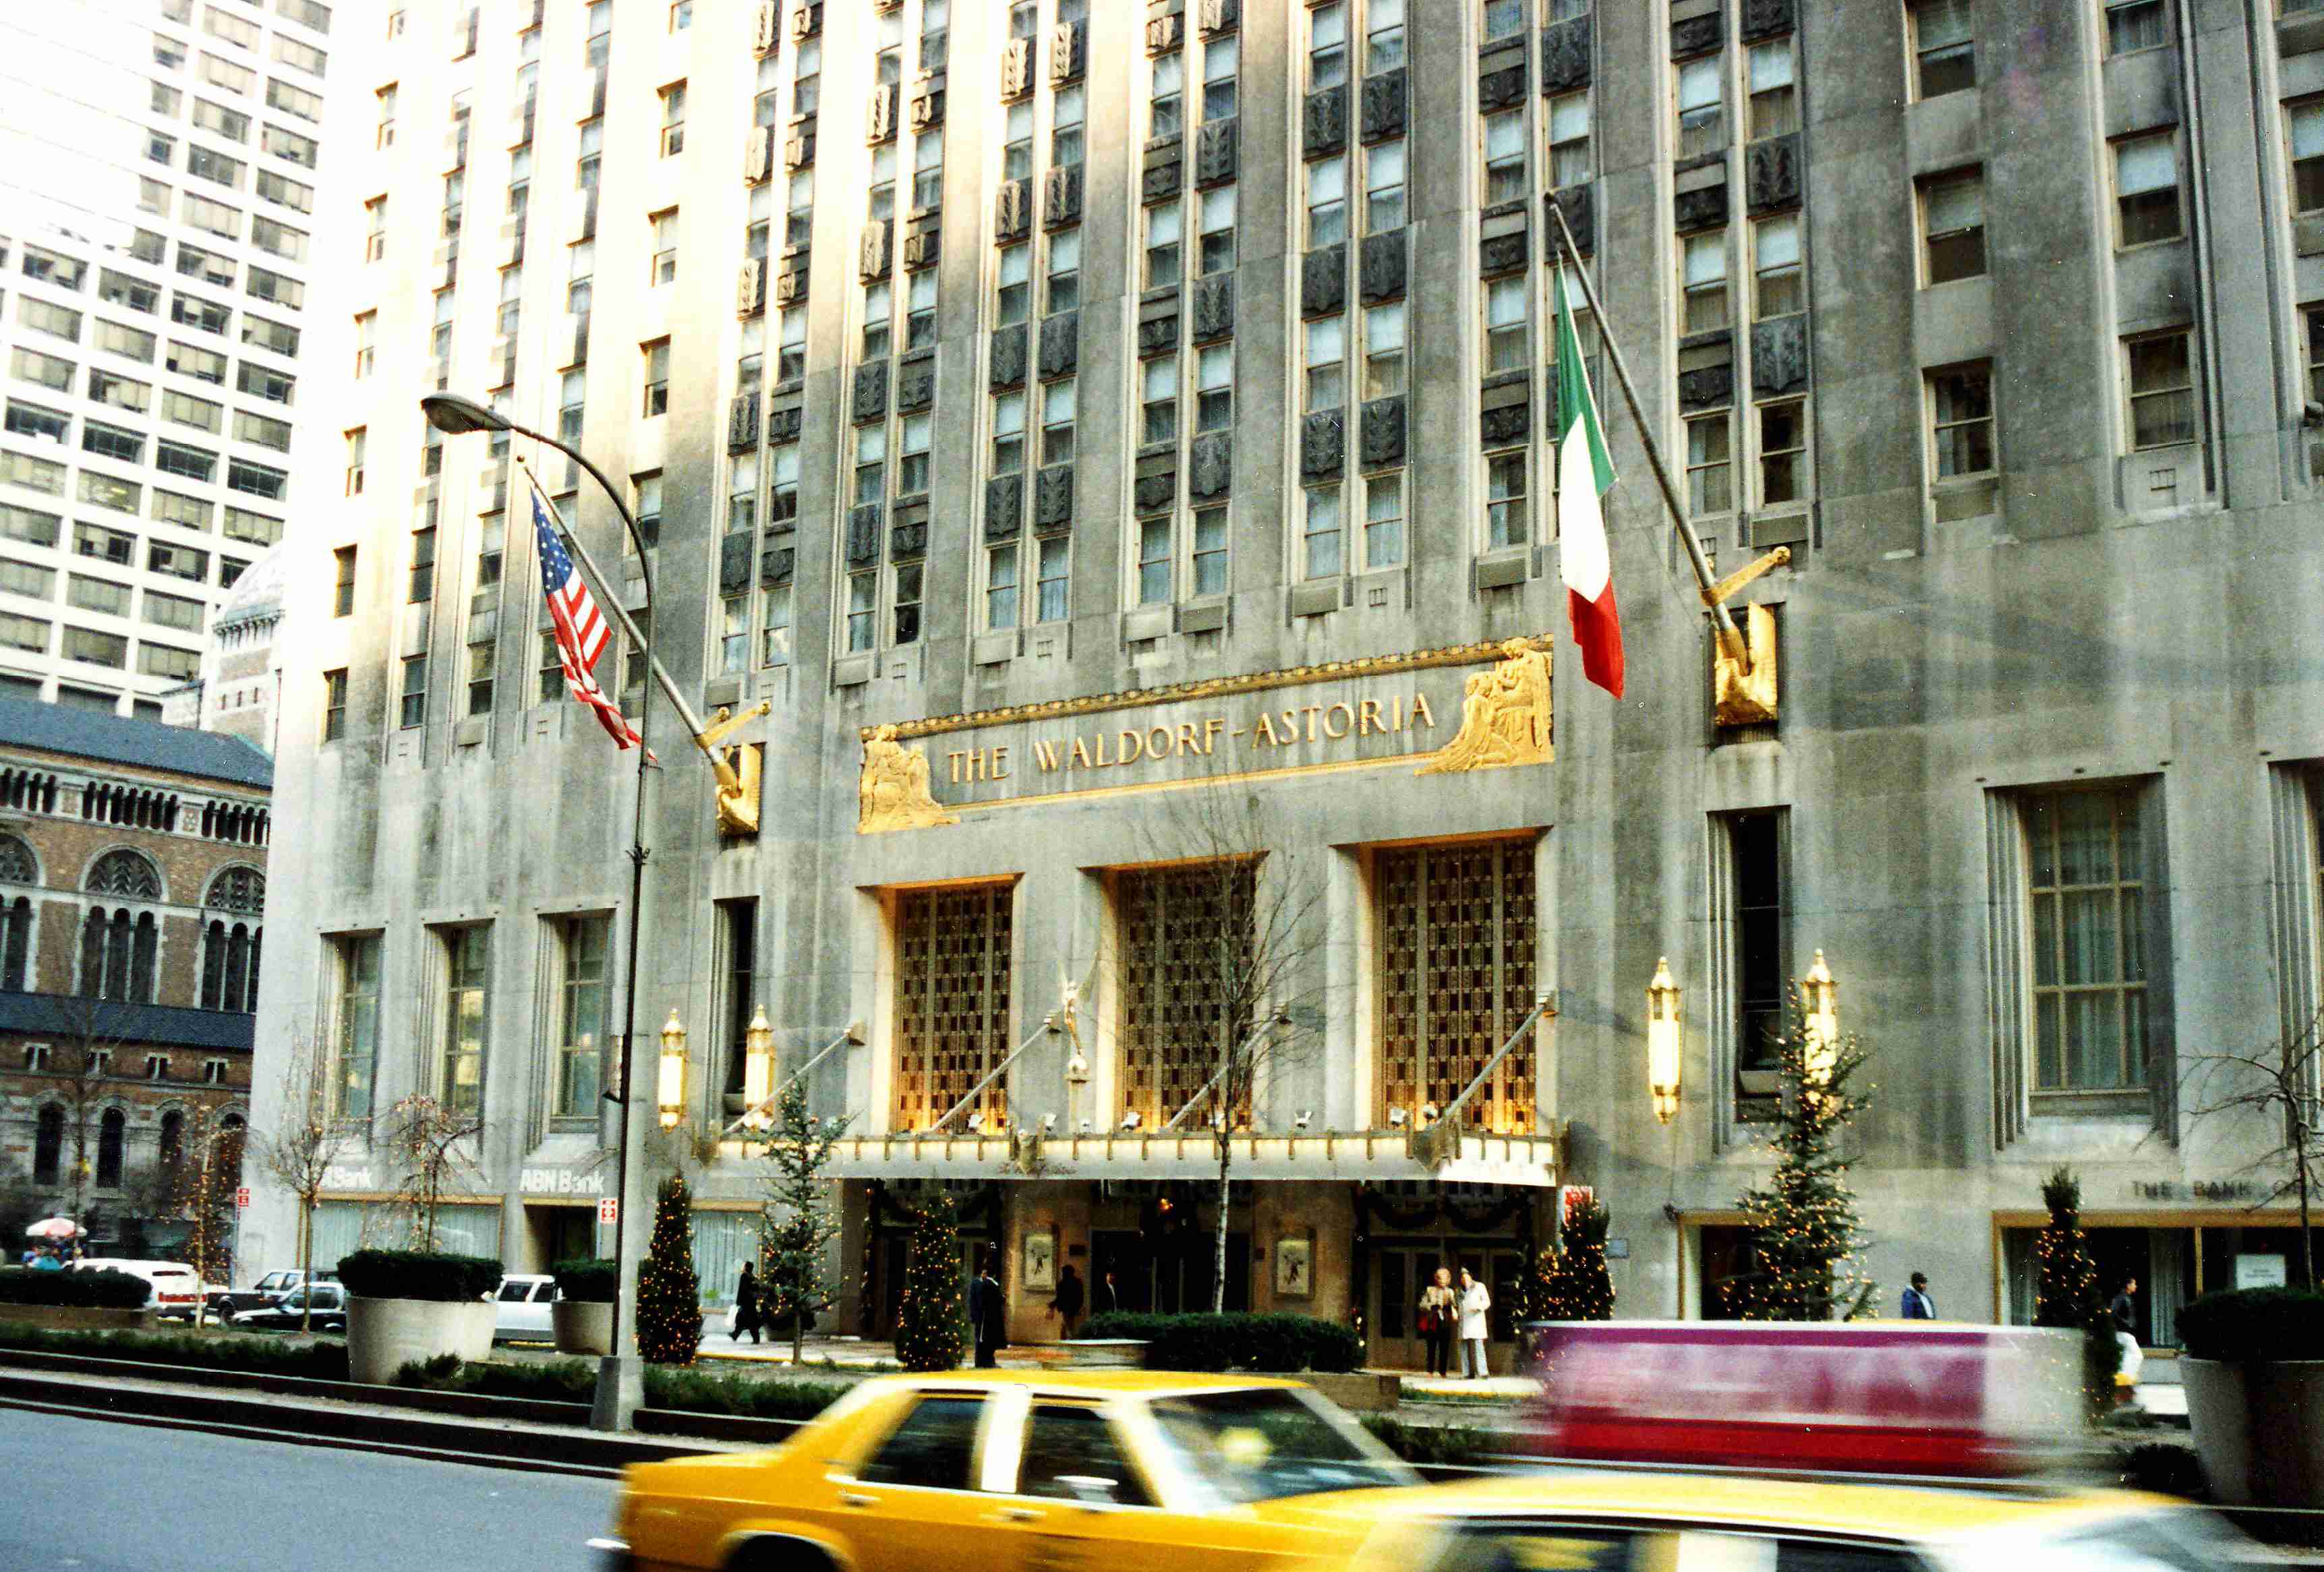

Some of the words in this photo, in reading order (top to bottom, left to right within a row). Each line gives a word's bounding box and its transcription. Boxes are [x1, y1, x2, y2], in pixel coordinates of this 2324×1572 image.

[949, 744, 1010, 784] THE
[519, 1168, 557, 1192] ABN
[558, 1169, 604, 1193] Bank
